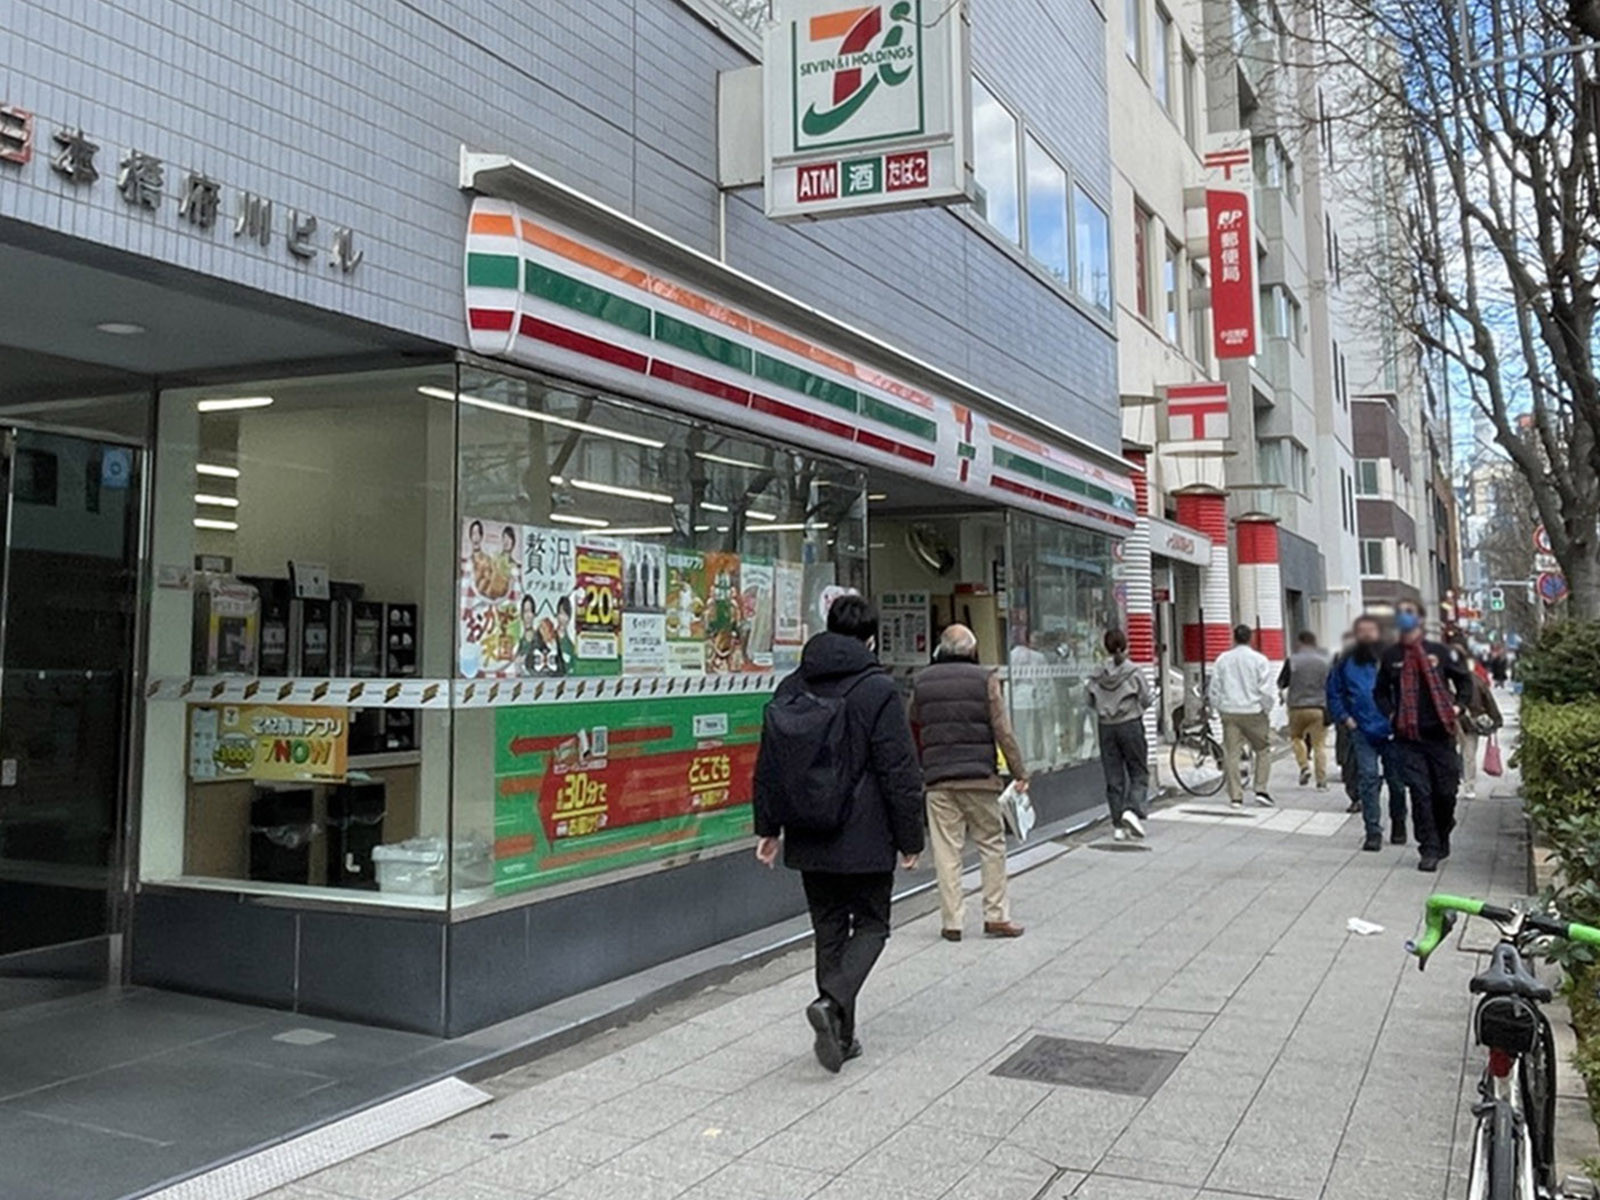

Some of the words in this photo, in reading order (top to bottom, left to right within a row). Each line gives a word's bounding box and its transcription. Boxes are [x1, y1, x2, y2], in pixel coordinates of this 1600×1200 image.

[852, 46, 914, 67] HOLDINGS
[799, 167, 836, 198] ATM
[849, 163, 874, 191] 酒
[887, 156, 928, 187] たばこ
[1220, 231, 1241, 283] 郵便局
[524, 532, 572, 576] 贅沢
[585, 584, 612, 624] 20
